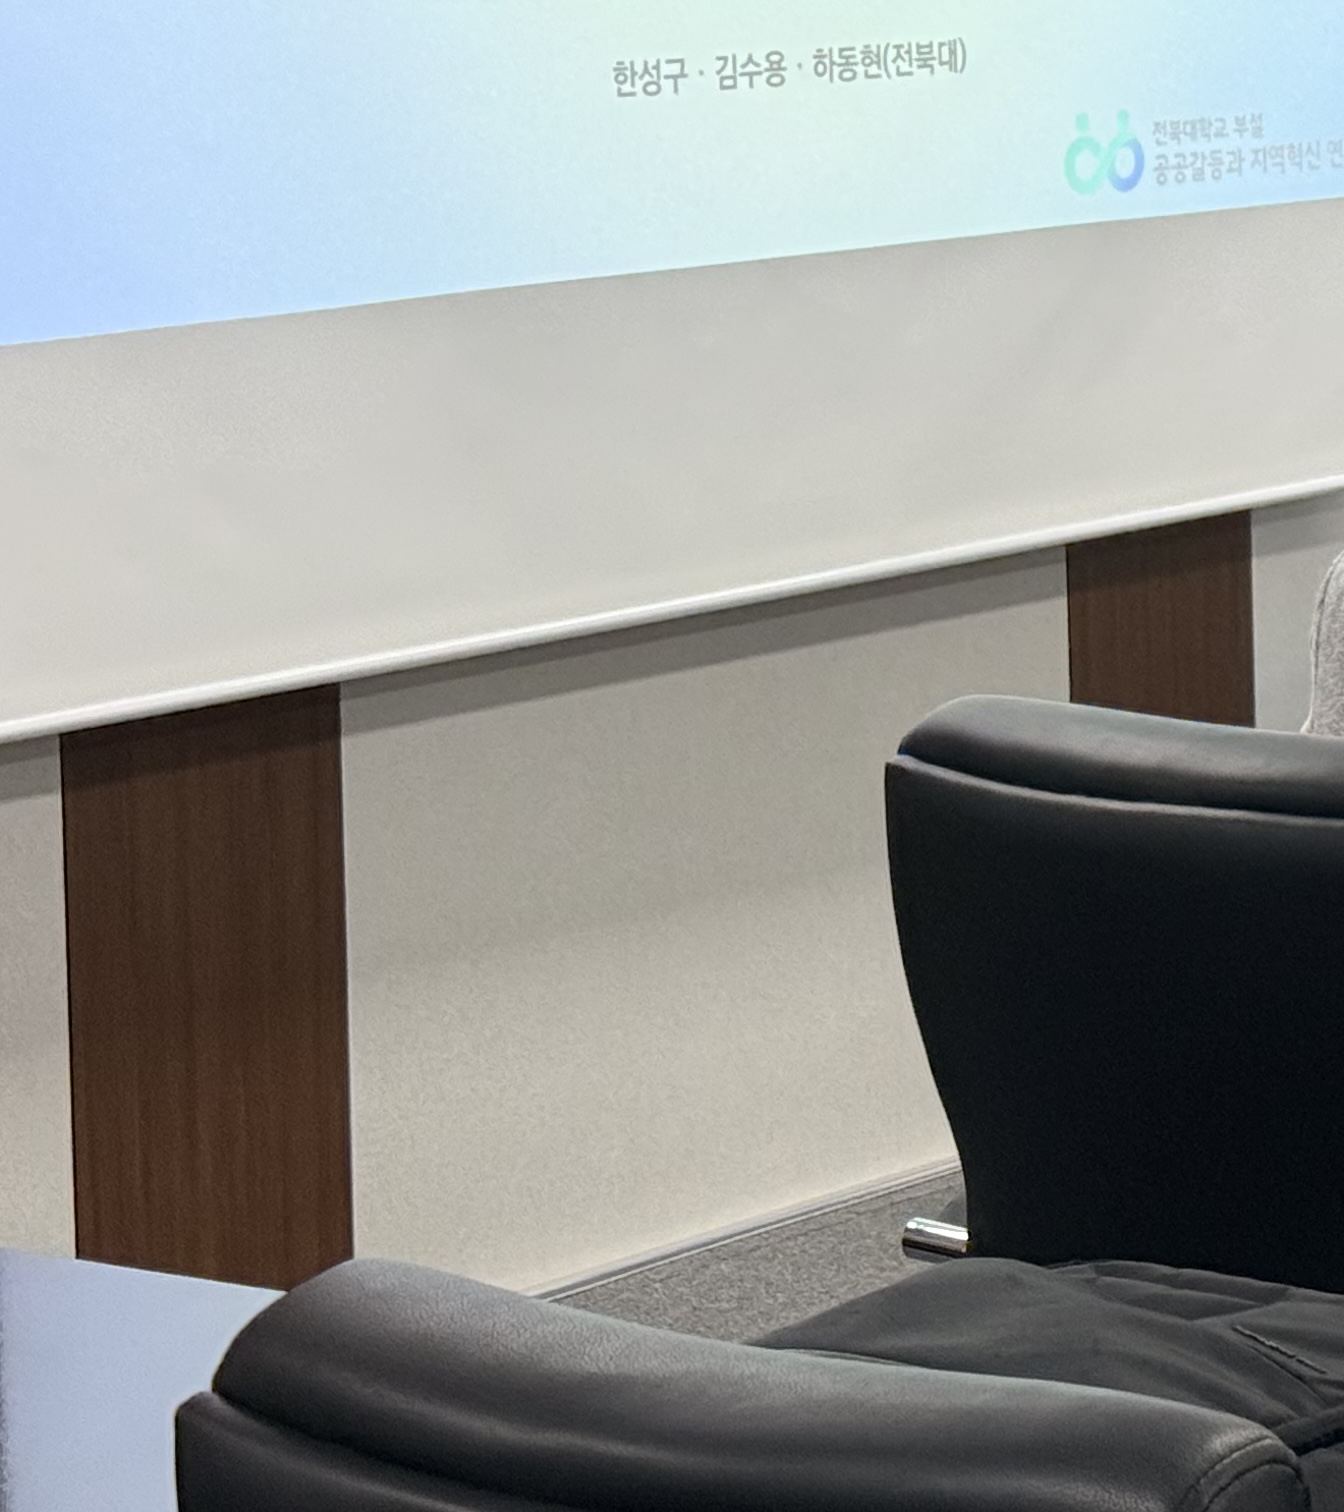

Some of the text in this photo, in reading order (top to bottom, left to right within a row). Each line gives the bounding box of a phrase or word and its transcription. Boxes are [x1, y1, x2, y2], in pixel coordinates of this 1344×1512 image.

[612, 57, 689, 98] 한성구
[714, 49, 788, 91] 김수용
[811, 36, 968, 84] 하동현(전북대)
[1152, 112, 1265, 147] 전북대학교 부설
[1153, 147, 1246, 187] 공공갈등과
[1249, 141, 1322, 175] 지역혁신
